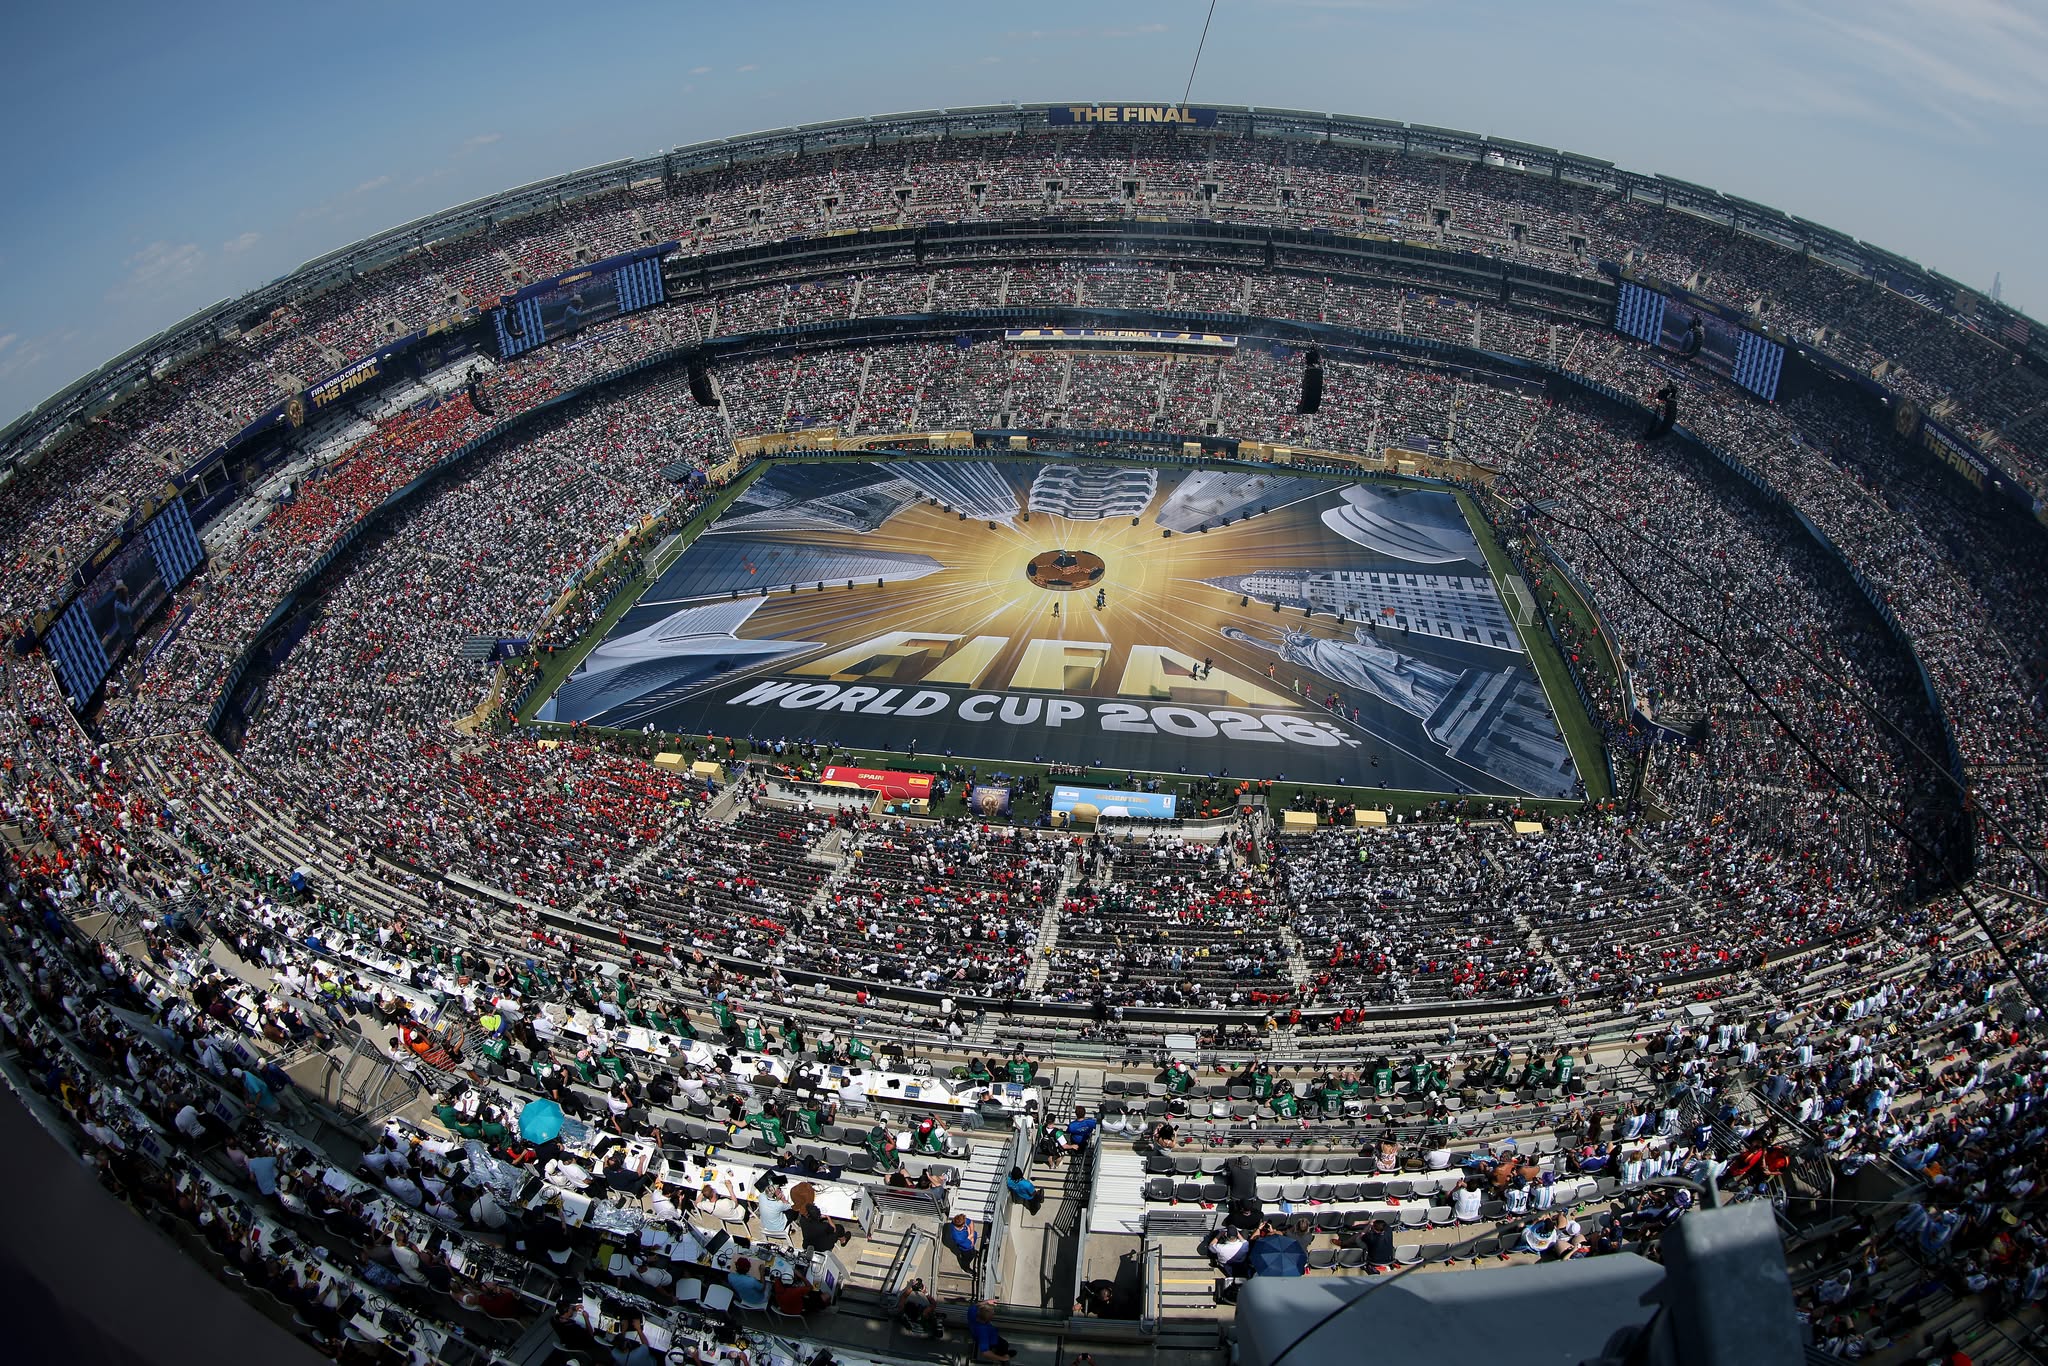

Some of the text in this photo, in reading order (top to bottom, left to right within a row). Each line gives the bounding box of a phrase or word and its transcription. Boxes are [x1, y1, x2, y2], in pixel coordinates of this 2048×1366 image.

[1069, 107, 1196, 123] THE FINAL
[311, 357, 378, 398] FIFA WORLD CUP 2026
[313, 365, 380, 408] THE FINAL
[1923, 431, 1985, 491] THE FINAL
[1924, 423, 1989, 476] FIFA WORLD CUP 2026
[783, 631, 1305, 708] FIFA
[726, 681, 1341, 747] WORLD CUP 2026
[857, 773, 885, 781] SPAIN
